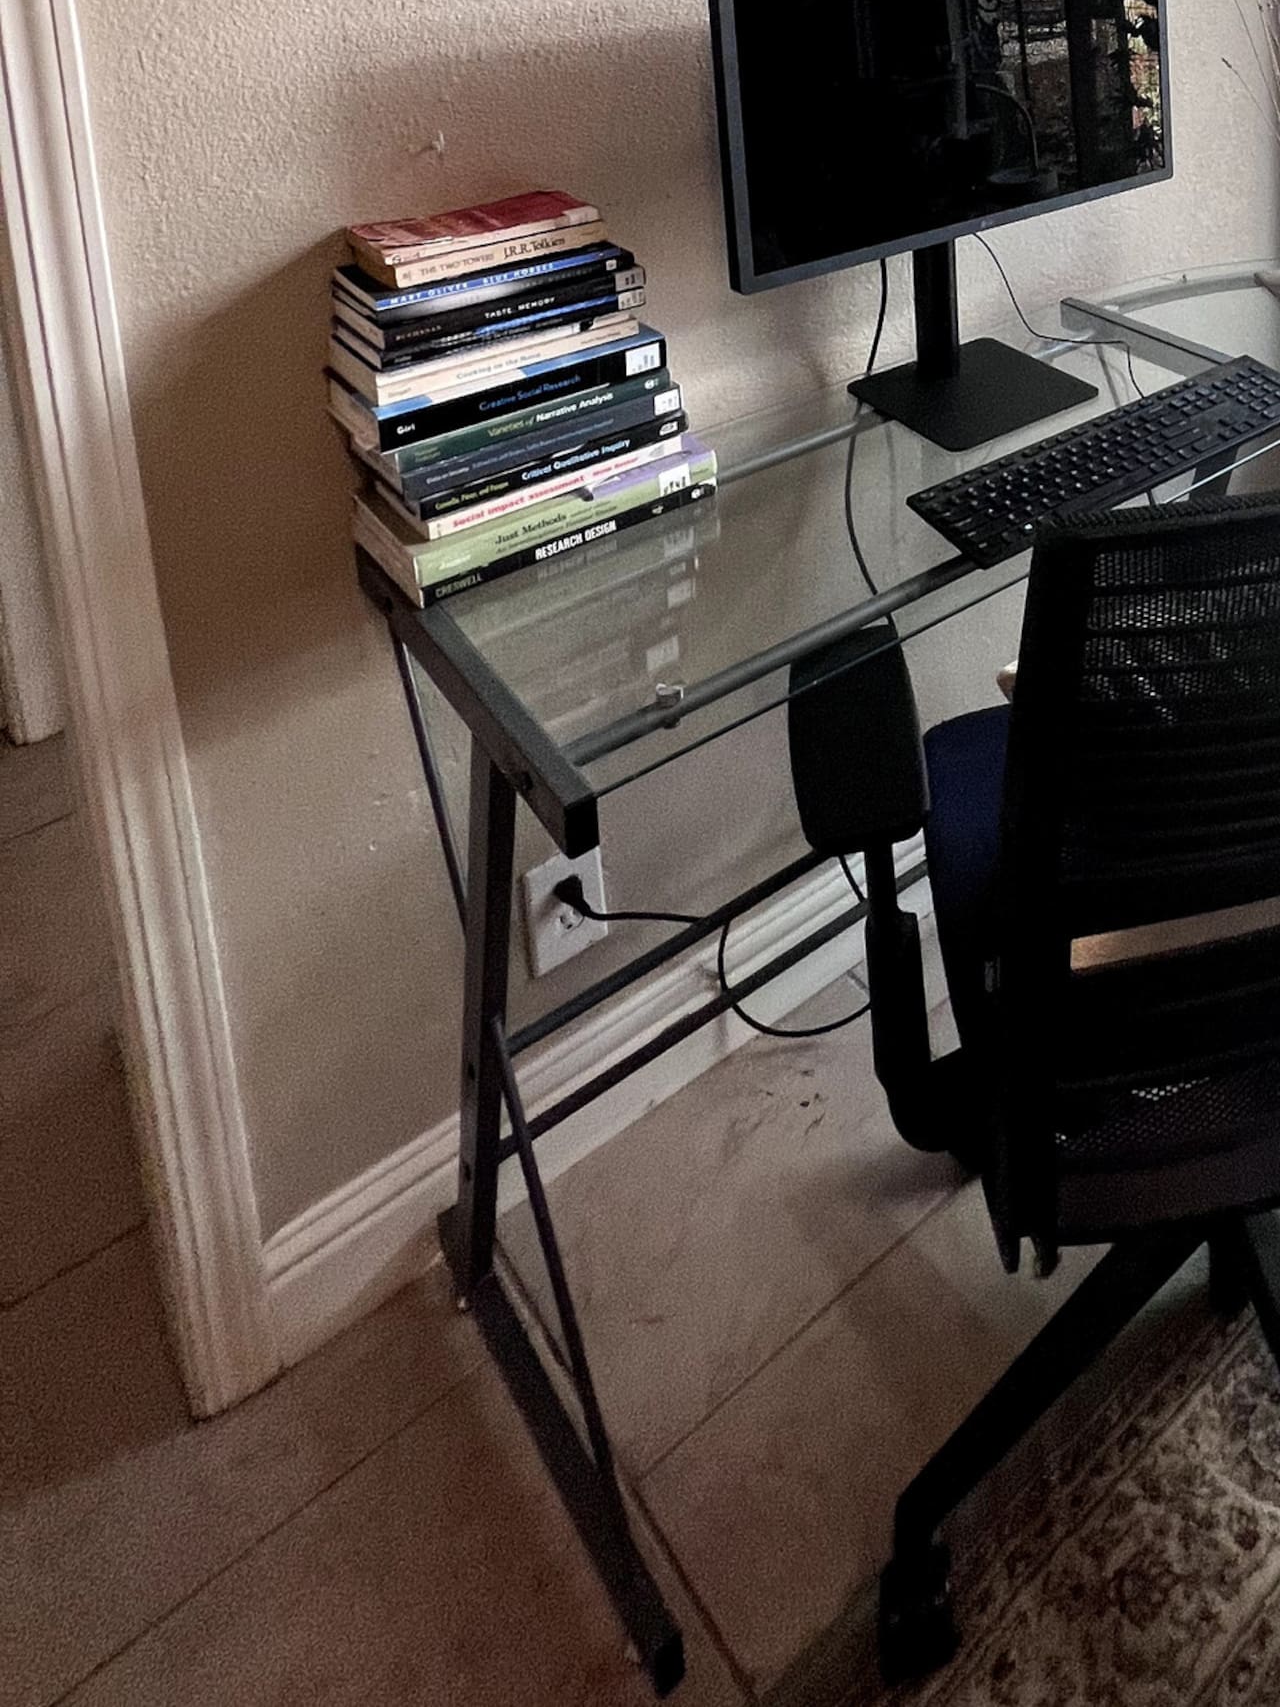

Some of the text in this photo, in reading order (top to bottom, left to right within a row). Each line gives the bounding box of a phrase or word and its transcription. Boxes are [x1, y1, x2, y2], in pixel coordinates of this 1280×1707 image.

[440, 259, 460, 271] TWO
[531, 236, 566, 252] Tolkien
[390, 290, 422, 305] MARY
[479, 374, 581, 412] Creative Social Research
[536, 403, 578, 423] Narrative
[579, 392, 614, 410] Analysis
[521, 465, 552, 482] Critical
[601, 438, 631, 456] Inquiry
[452, 509, 485, 529] Social
[487, 494, 526, 516] impact
[494, 528, 519, 545] Just
[521, 512, 568, 535] Methods
[535, 533, 584, 561] RESEARCH
[584, 519, 618, 543] DESIGN
